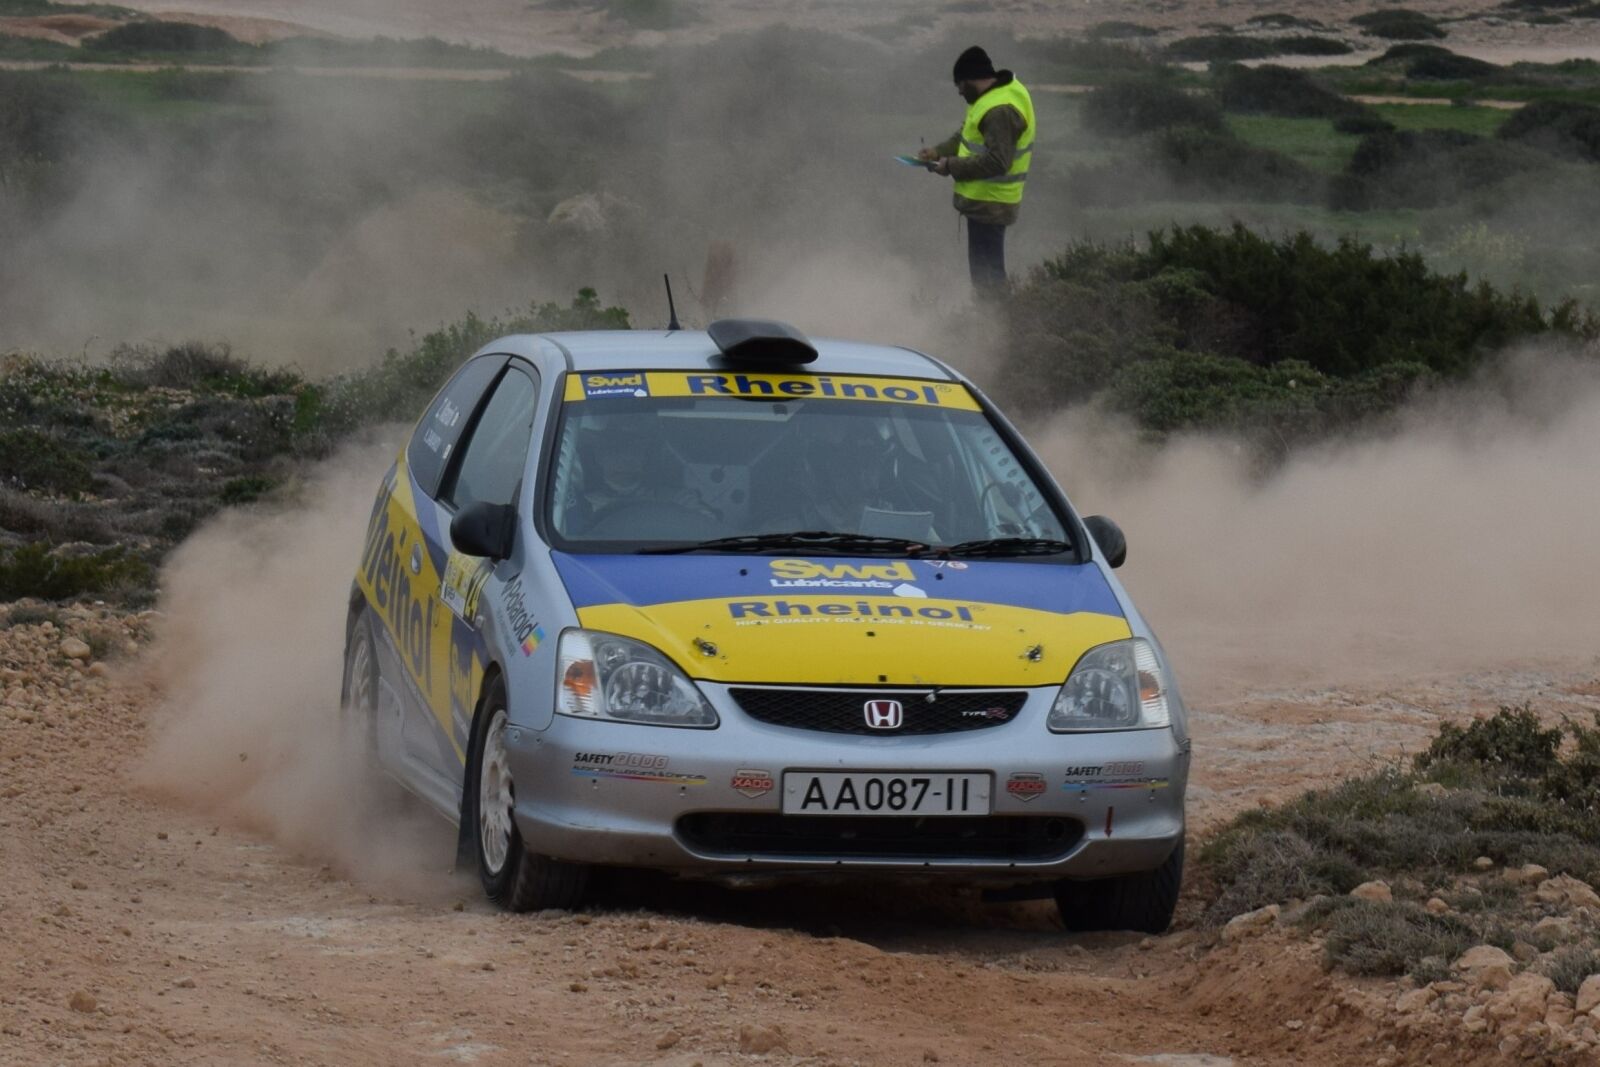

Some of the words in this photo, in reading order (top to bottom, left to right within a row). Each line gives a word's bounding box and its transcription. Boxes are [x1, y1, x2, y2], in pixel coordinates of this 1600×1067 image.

[687, 374, 940, 405] Rheinol
[769, 559, 916, 582] Swd
[770, 578, 894, 589] Lubricants
[728, 601, 973, 622] Rheinol
[574, 752, 615, 765] SAFETY
[1065, 766, 1104, 777] SAFETY
